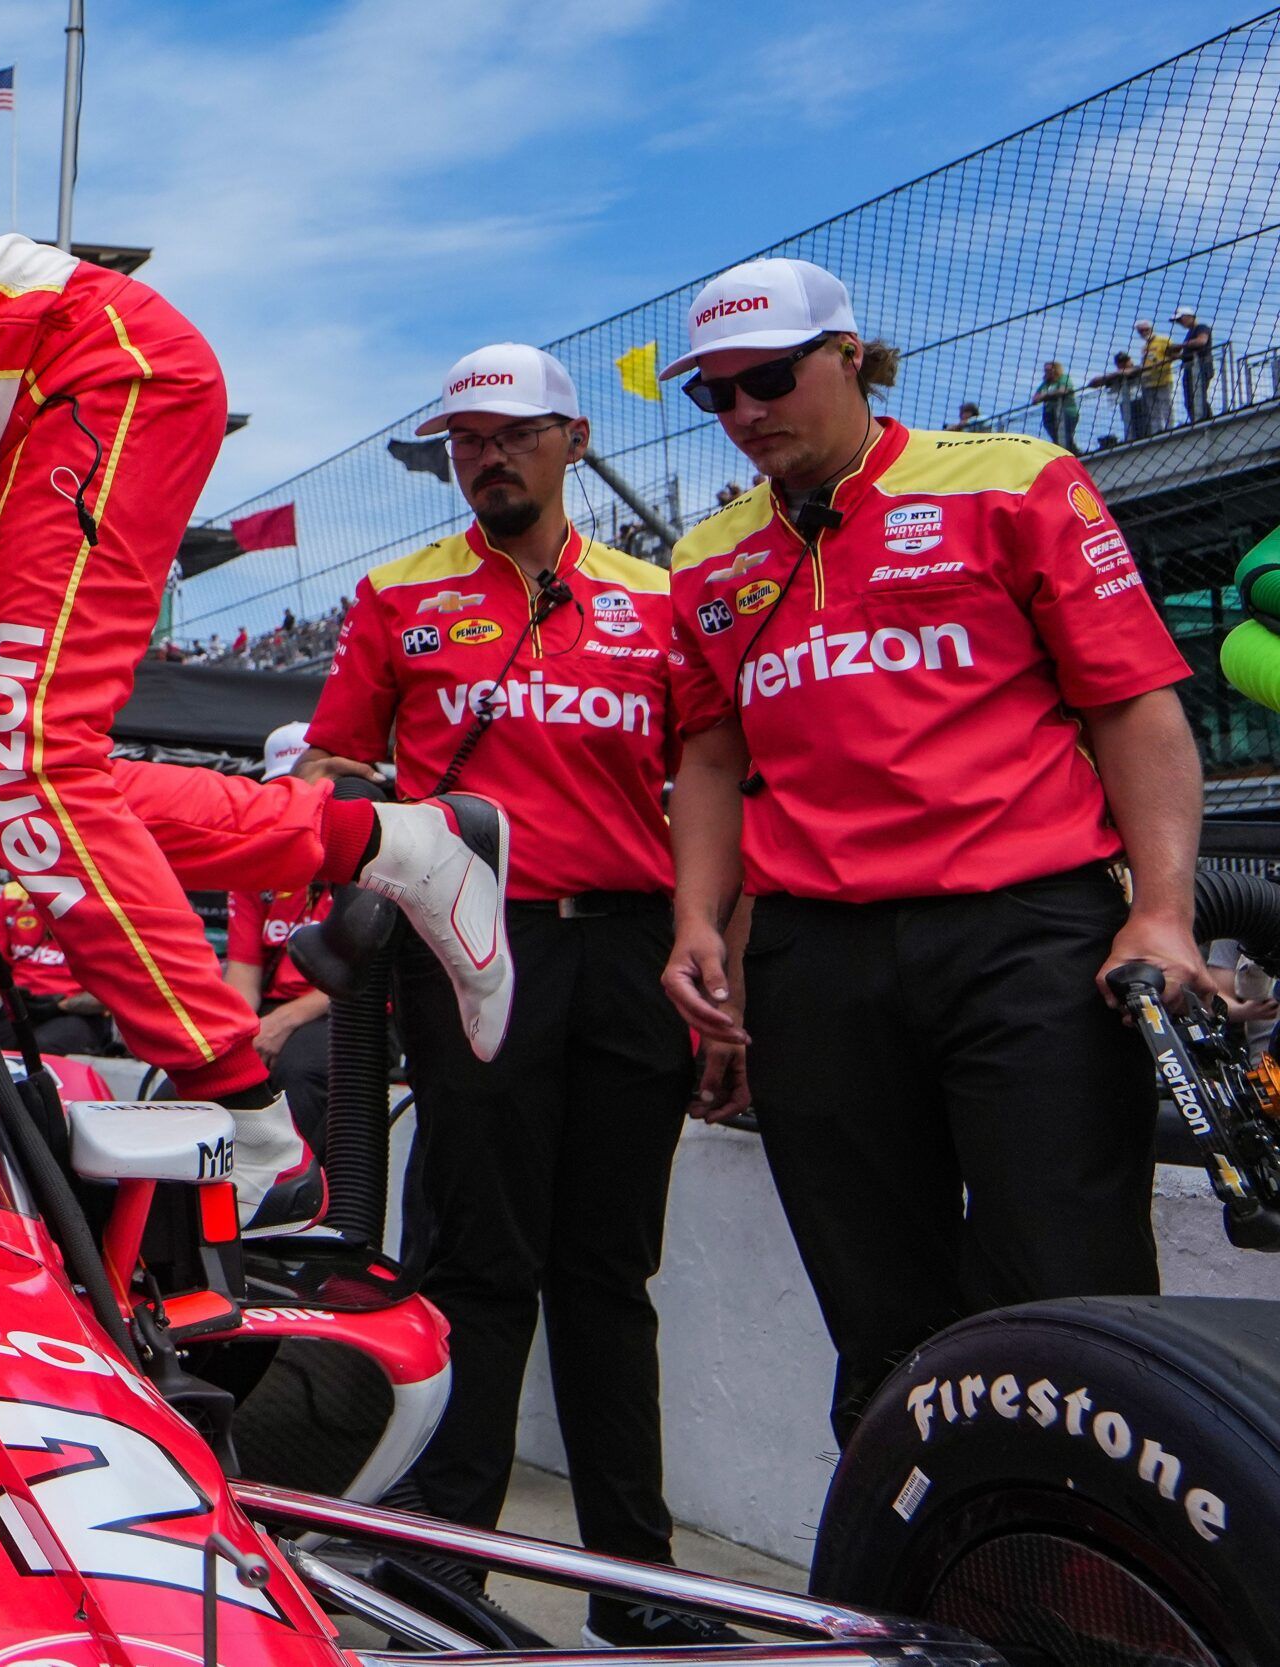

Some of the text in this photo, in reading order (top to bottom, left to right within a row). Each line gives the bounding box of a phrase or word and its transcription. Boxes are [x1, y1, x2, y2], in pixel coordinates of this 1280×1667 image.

[696, 296, 769, 327] verizon
[449, 372, 514, 396] verizon
[910, 511, 937, 520] NTT
[885, 523, 942, 536] INDYCAR
[869, 561, 964, 583] Snap-on
[1094, 571, 1142, 600] SIEM
[701, 604, 730, 630] PPG
[404, 629, 438, 653] PPG
[456, 624, 495, 639] PENNZOIL
[584, 640, 660, 658] Snap-on
[740, 621, 974, 708] verizon
[437, 671, 651, 737] verizon
[1157, 1048, 1212, 1137] verizon
[88, 1104, 215, 1112] SIEMENS
[908, 1373, 1227, 1543] Firestone
